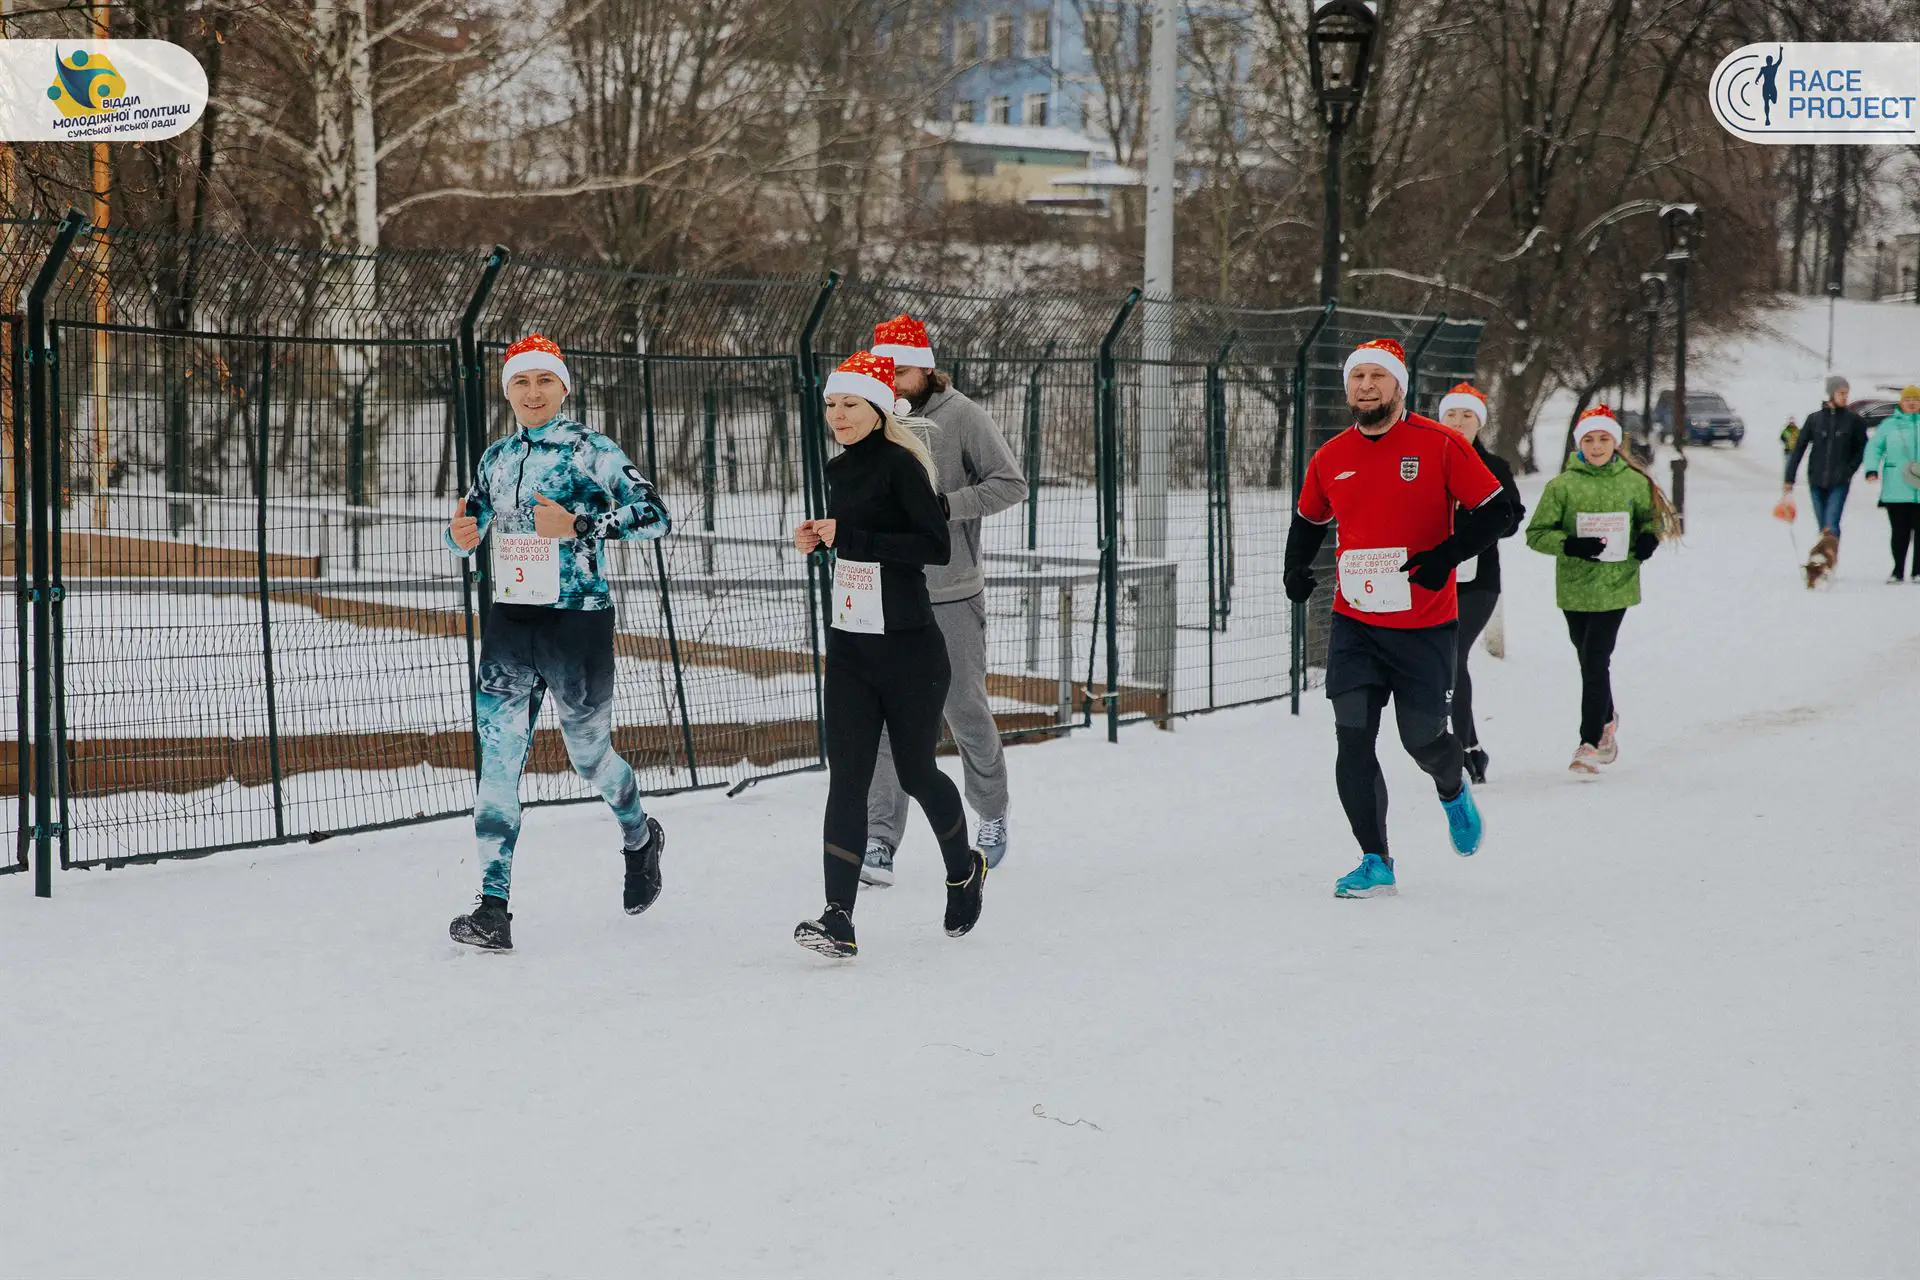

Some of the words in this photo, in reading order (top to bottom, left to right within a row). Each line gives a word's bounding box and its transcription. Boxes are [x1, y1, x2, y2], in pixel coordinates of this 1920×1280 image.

[515, 567, 524, 582] 3
[1364, 579, 1373, 593] 6
[845, 595, 852, 610] 4
